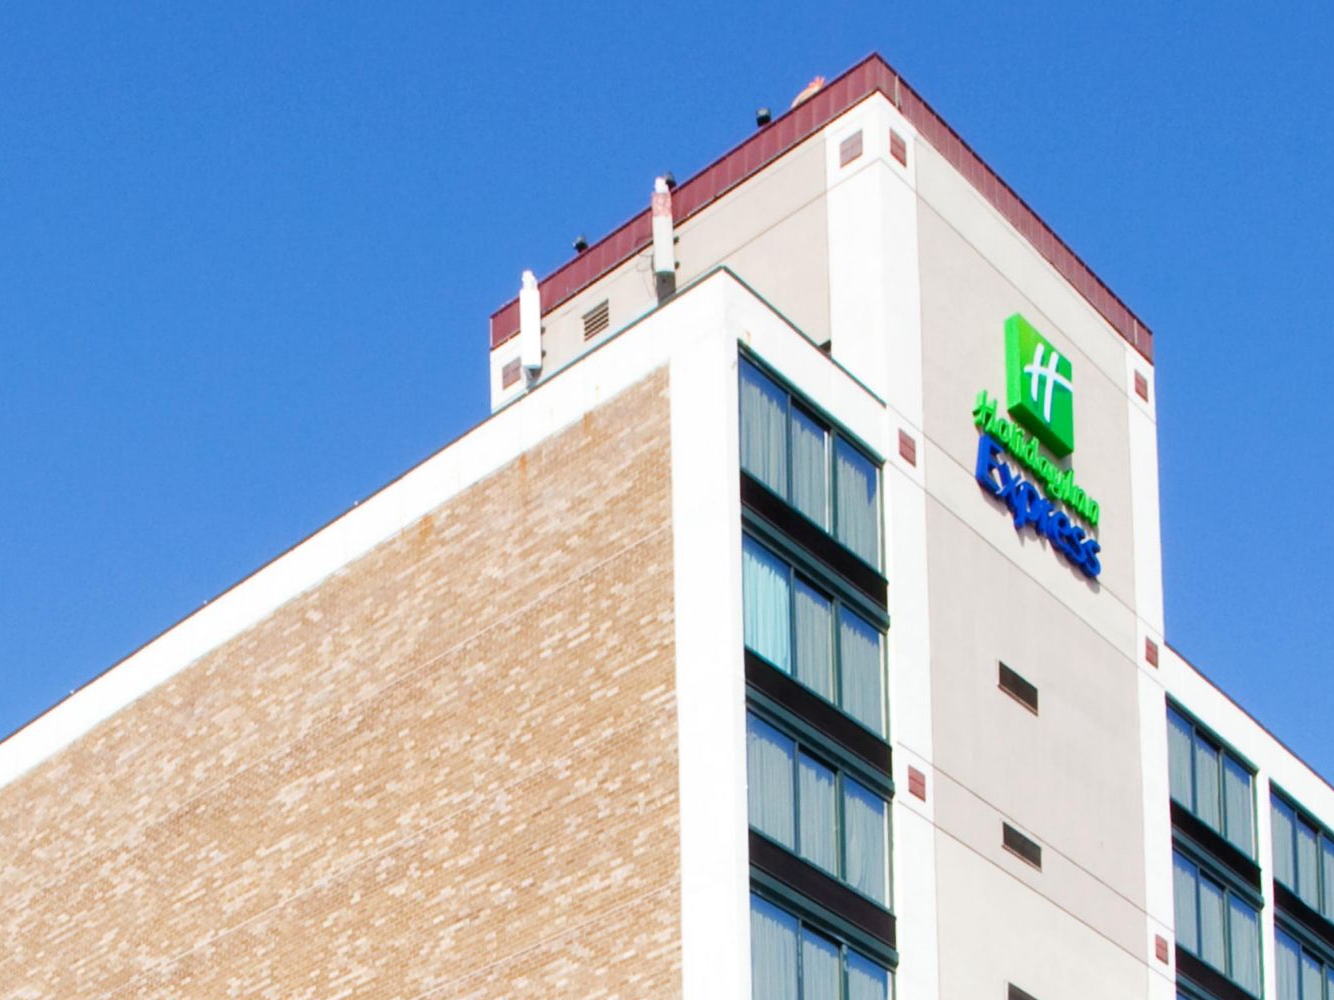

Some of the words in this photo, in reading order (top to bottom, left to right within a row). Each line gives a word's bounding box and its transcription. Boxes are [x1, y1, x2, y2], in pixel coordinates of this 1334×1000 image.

[972, 390, 1065, 500] Holiday
[1063, 468, 1100, 526] Inn
[976, 434, 1101, 577] Express
